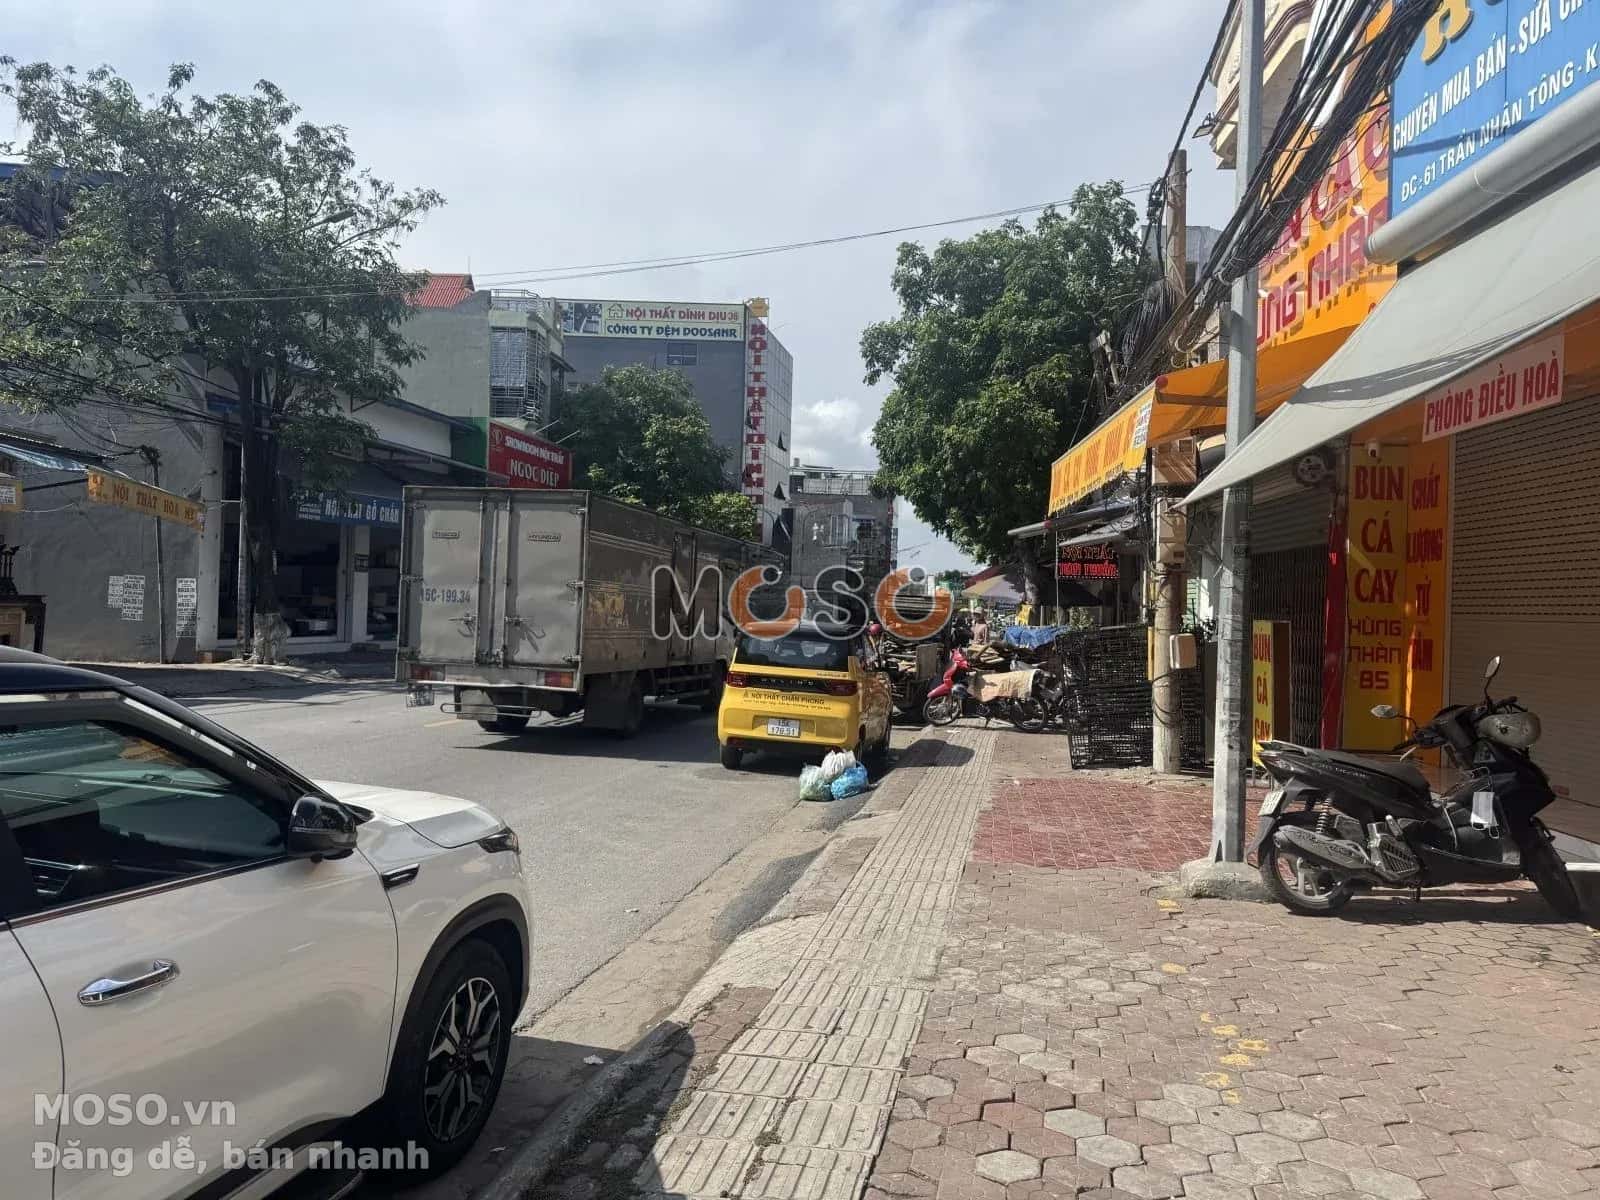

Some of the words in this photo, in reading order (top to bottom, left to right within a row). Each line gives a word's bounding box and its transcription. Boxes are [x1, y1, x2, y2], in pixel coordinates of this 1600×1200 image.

[1393, 91, 1438, 152] CHUYÊN
[1441, 64, 1471, 116] MUA
[1440, 127, 1475, 175] TRẦN
[1479, 98, 1523, 148] NHÂN
[606, 322, 638, 335] CÔNG
[640, 325, 654, 336] TY
[626, 306, 646, 321] NỘI
[649, 305, 675, 320] THẤT
[1425, 387, 1474, 436] PHÒNG
[1478, 362, 1517, 420] ĐIỀU
[1522, 350, 1560, 406] HOÀ
[1354, 457, 1404, 501] BÚN
[1360, 511, 1394, 554] CÁ
[1355, 567, 1399, 605] CAY
